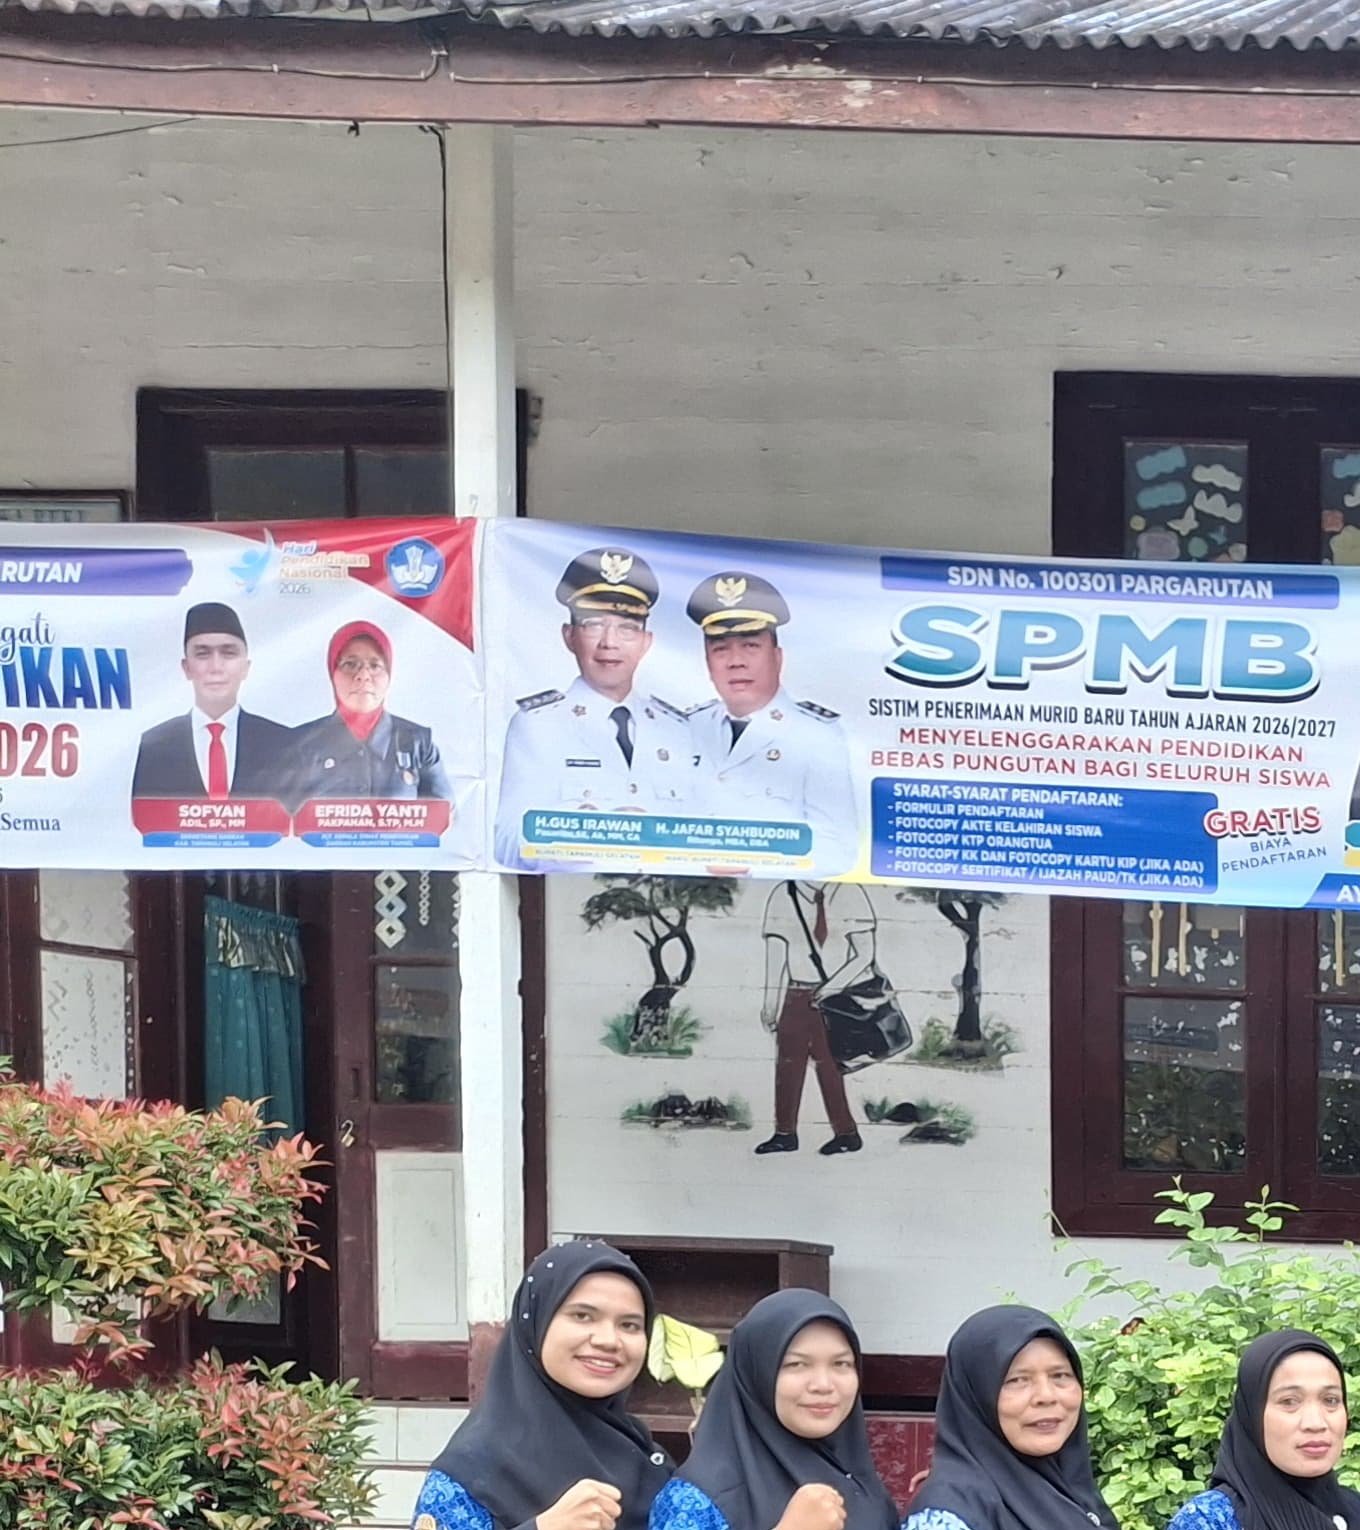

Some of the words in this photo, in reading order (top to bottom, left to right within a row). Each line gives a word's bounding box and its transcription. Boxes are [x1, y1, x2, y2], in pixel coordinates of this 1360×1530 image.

[947, 566, 993, 587] SDN
[999, 569, 1035, 589] No.
[1039, 570, 1115, 592] 100301
[1121, 574, 1273, 599] PARGARUTAN
[886, 604, 1321, 703] SPMB
[869, 698, 919, 718] SISTIM
[924, 700, 1024, 722] PENERIMAAN
[1030, 705, 1078, 724] MURID
[1084, 706, 1124, 726] BARU
[1130, 709, 1179, 730] TAHUN
[1185, 713, 1247, 734] AJARAN
[1253, 715, 1336, 738] 2026/2027
[899, 727, 1152, 754] MENYELENGGARAKAN
[1161, 739, 1303, 762] PENDIDIKAN
[871, 751, 944, 769] BEBAS
[953, 754, 1076, 775] PUNGUTAN
[1085, 759, 1138, 777] BAGI
[1146, 763, 1250, 783] SELURUH
[1259, 768, 1331, 788] SISWA
[893, 783, 1008, 802] SYARAT-SYARAT
[1012, 788, 1124, 808] PENDAFTARAN:
[1, 812, 61, 831] Semua
[179, 805, 245, 817] SOFYAN
[315, 804, 373, 817] EFRIDA
[376, 804, 427, 817] YANTI
[895, 802, 955, 815] FORMULIR
[957, 806, 1044, 819] PENDAFTARAN
[535, 816, 579, 830] H.GUS
[582, 818, 642, 832] IRAWAN
[655, 822, 670, 834] H.
[672, 823, 713, 836] JAFAR
[716, 825, 800, 840] SYAHBUDDIN
[895, 817, 959, 830] FOTOCOPY
[961, 819, 993, 831] AKTE
[995, 822, 1062, 836] KELAHIRAN
[1065, 825, 1103, 837] SISWA
[1205, 807, 1321, 838] GRATIS
[895, 832, 959, 845] FOTOCOPY
[961, 834, 984, 846] KTP
[987, 835, 1053, 849] ORANGTUA
[1250, 837, 1292, 852] BIAYA
[895, 846, 959, 860] FOTOCOPY
[961, 849, 979, 861] KK
[981, 850, 1007, 863] DAN
[1009, 851, 1072, 866] FOTOCOPY
[1075, 855, 1114, 868] KARTU
[1117, 857, 1137, 869] KIP
[1222, 847, 1327, 873] PENDAFTARAN
[894, 861, 959, 875] FOTOCOPY
[962, 864, 1027, 878] SERTIFIKAT
[1084, 870, 1138, 885] PAUD/TK
